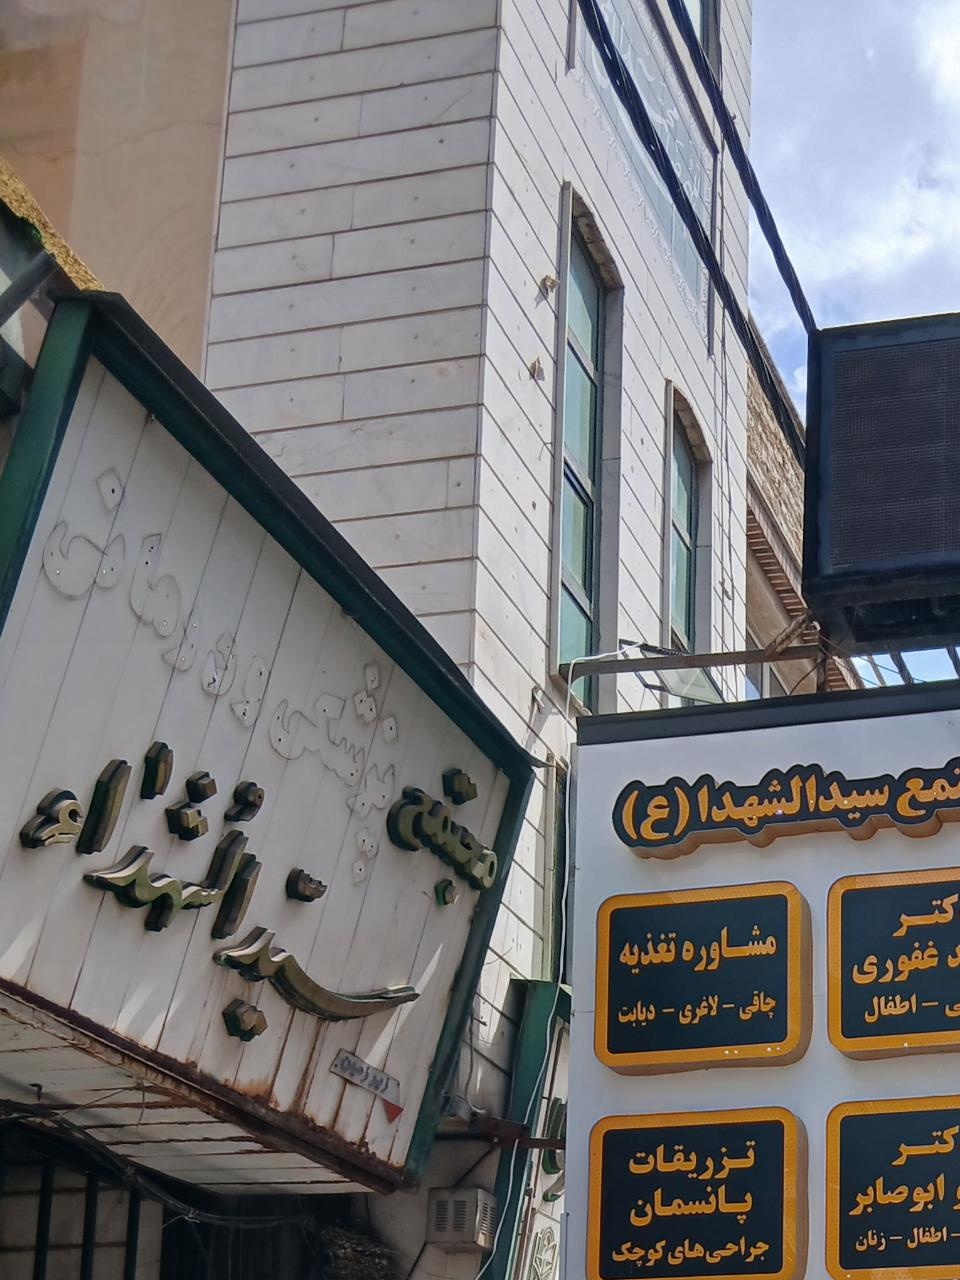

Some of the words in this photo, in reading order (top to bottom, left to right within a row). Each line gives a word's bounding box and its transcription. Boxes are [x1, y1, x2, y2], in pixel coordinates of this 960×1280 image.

[698, 773, 889, 827] سیدالشهدا
[620, 932, 675, 973] تغذیه
[683, 926, 776, 971] مشاوره
[852, 940, 938, 984] غفوری
[619, 1001, 655, 1024] دیابت
[679, 995, 718, 1024] لاغری
[740, 991, 776, 1020] چاقی
[865, 993, 916, 1023] اطفال
[629, 1140, 754, 1179] تزریقات
[630, 1183, 752, 1226] پانسمان
[849, 1174, 944, 1215] ابوصابر
[612, 1238, 666, 1266] کوچک
[856, 1230, 885, 1251] زنان
[907, 1226, 947, 1248] اطفال
